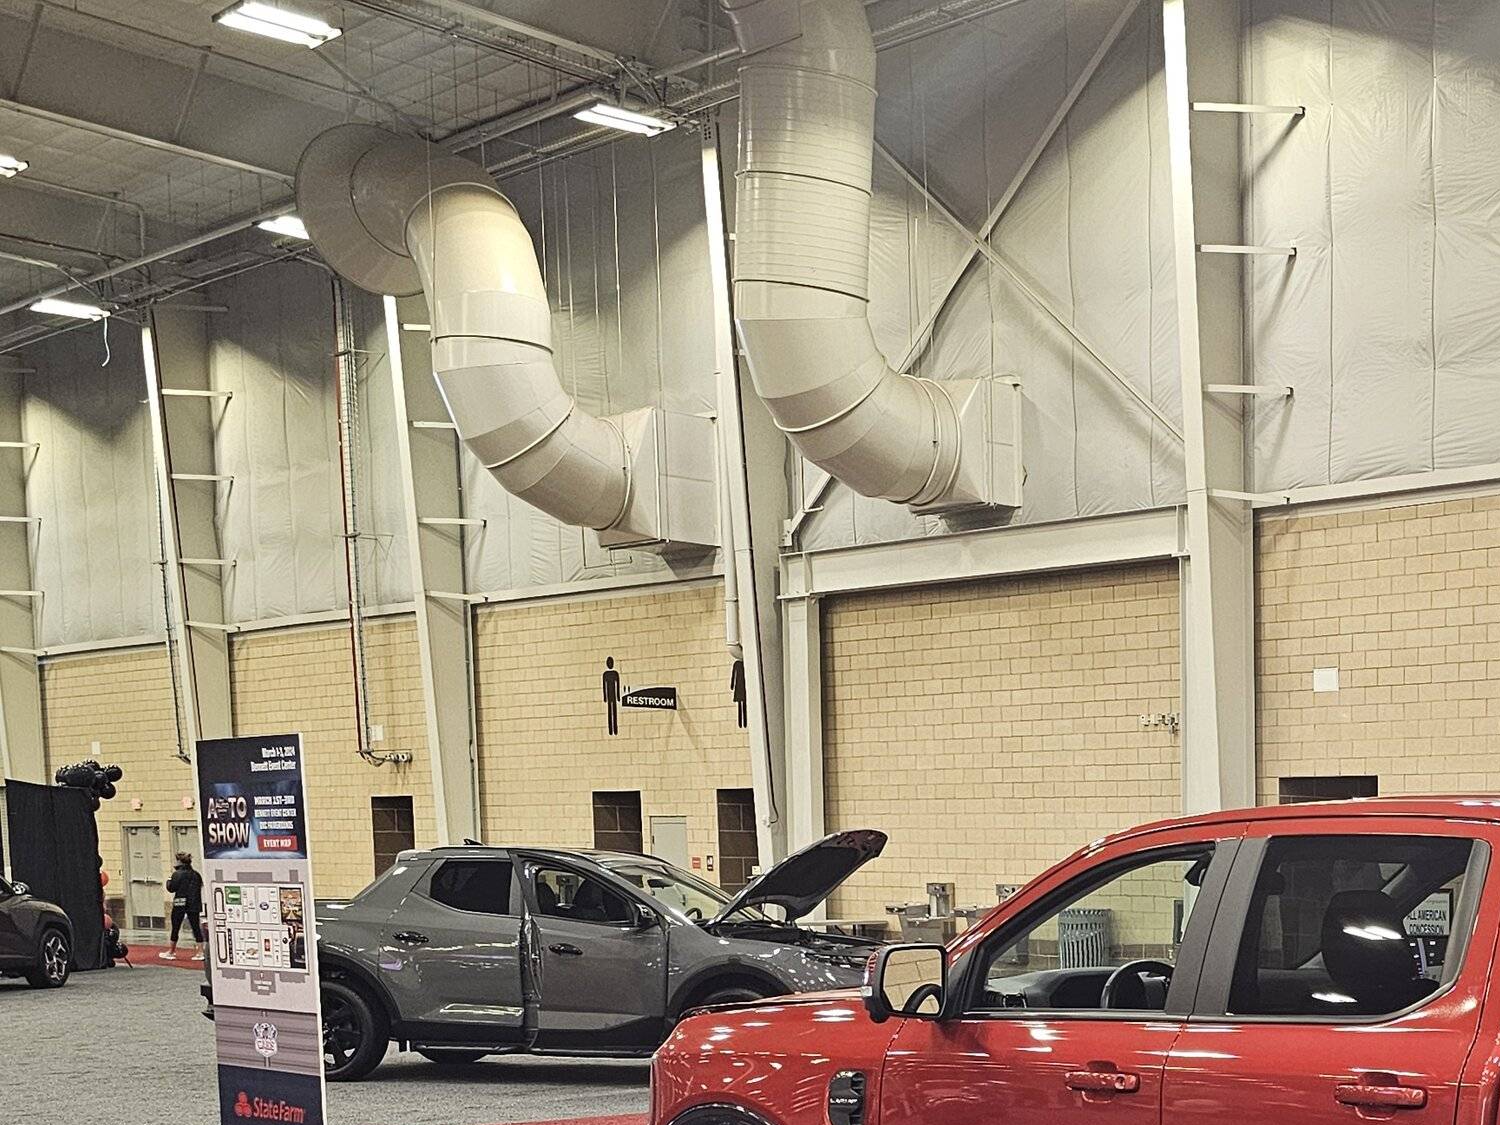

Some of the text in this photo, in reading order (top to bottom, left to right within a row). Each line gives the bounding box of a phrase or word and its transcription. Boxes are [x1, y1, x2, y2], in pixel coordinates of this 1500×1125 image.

[626, 695, 674, 706] RESTROOM
[208, 822, 249, 845] SHOW
[1418, 910, 1447, 921] AMERICAN
